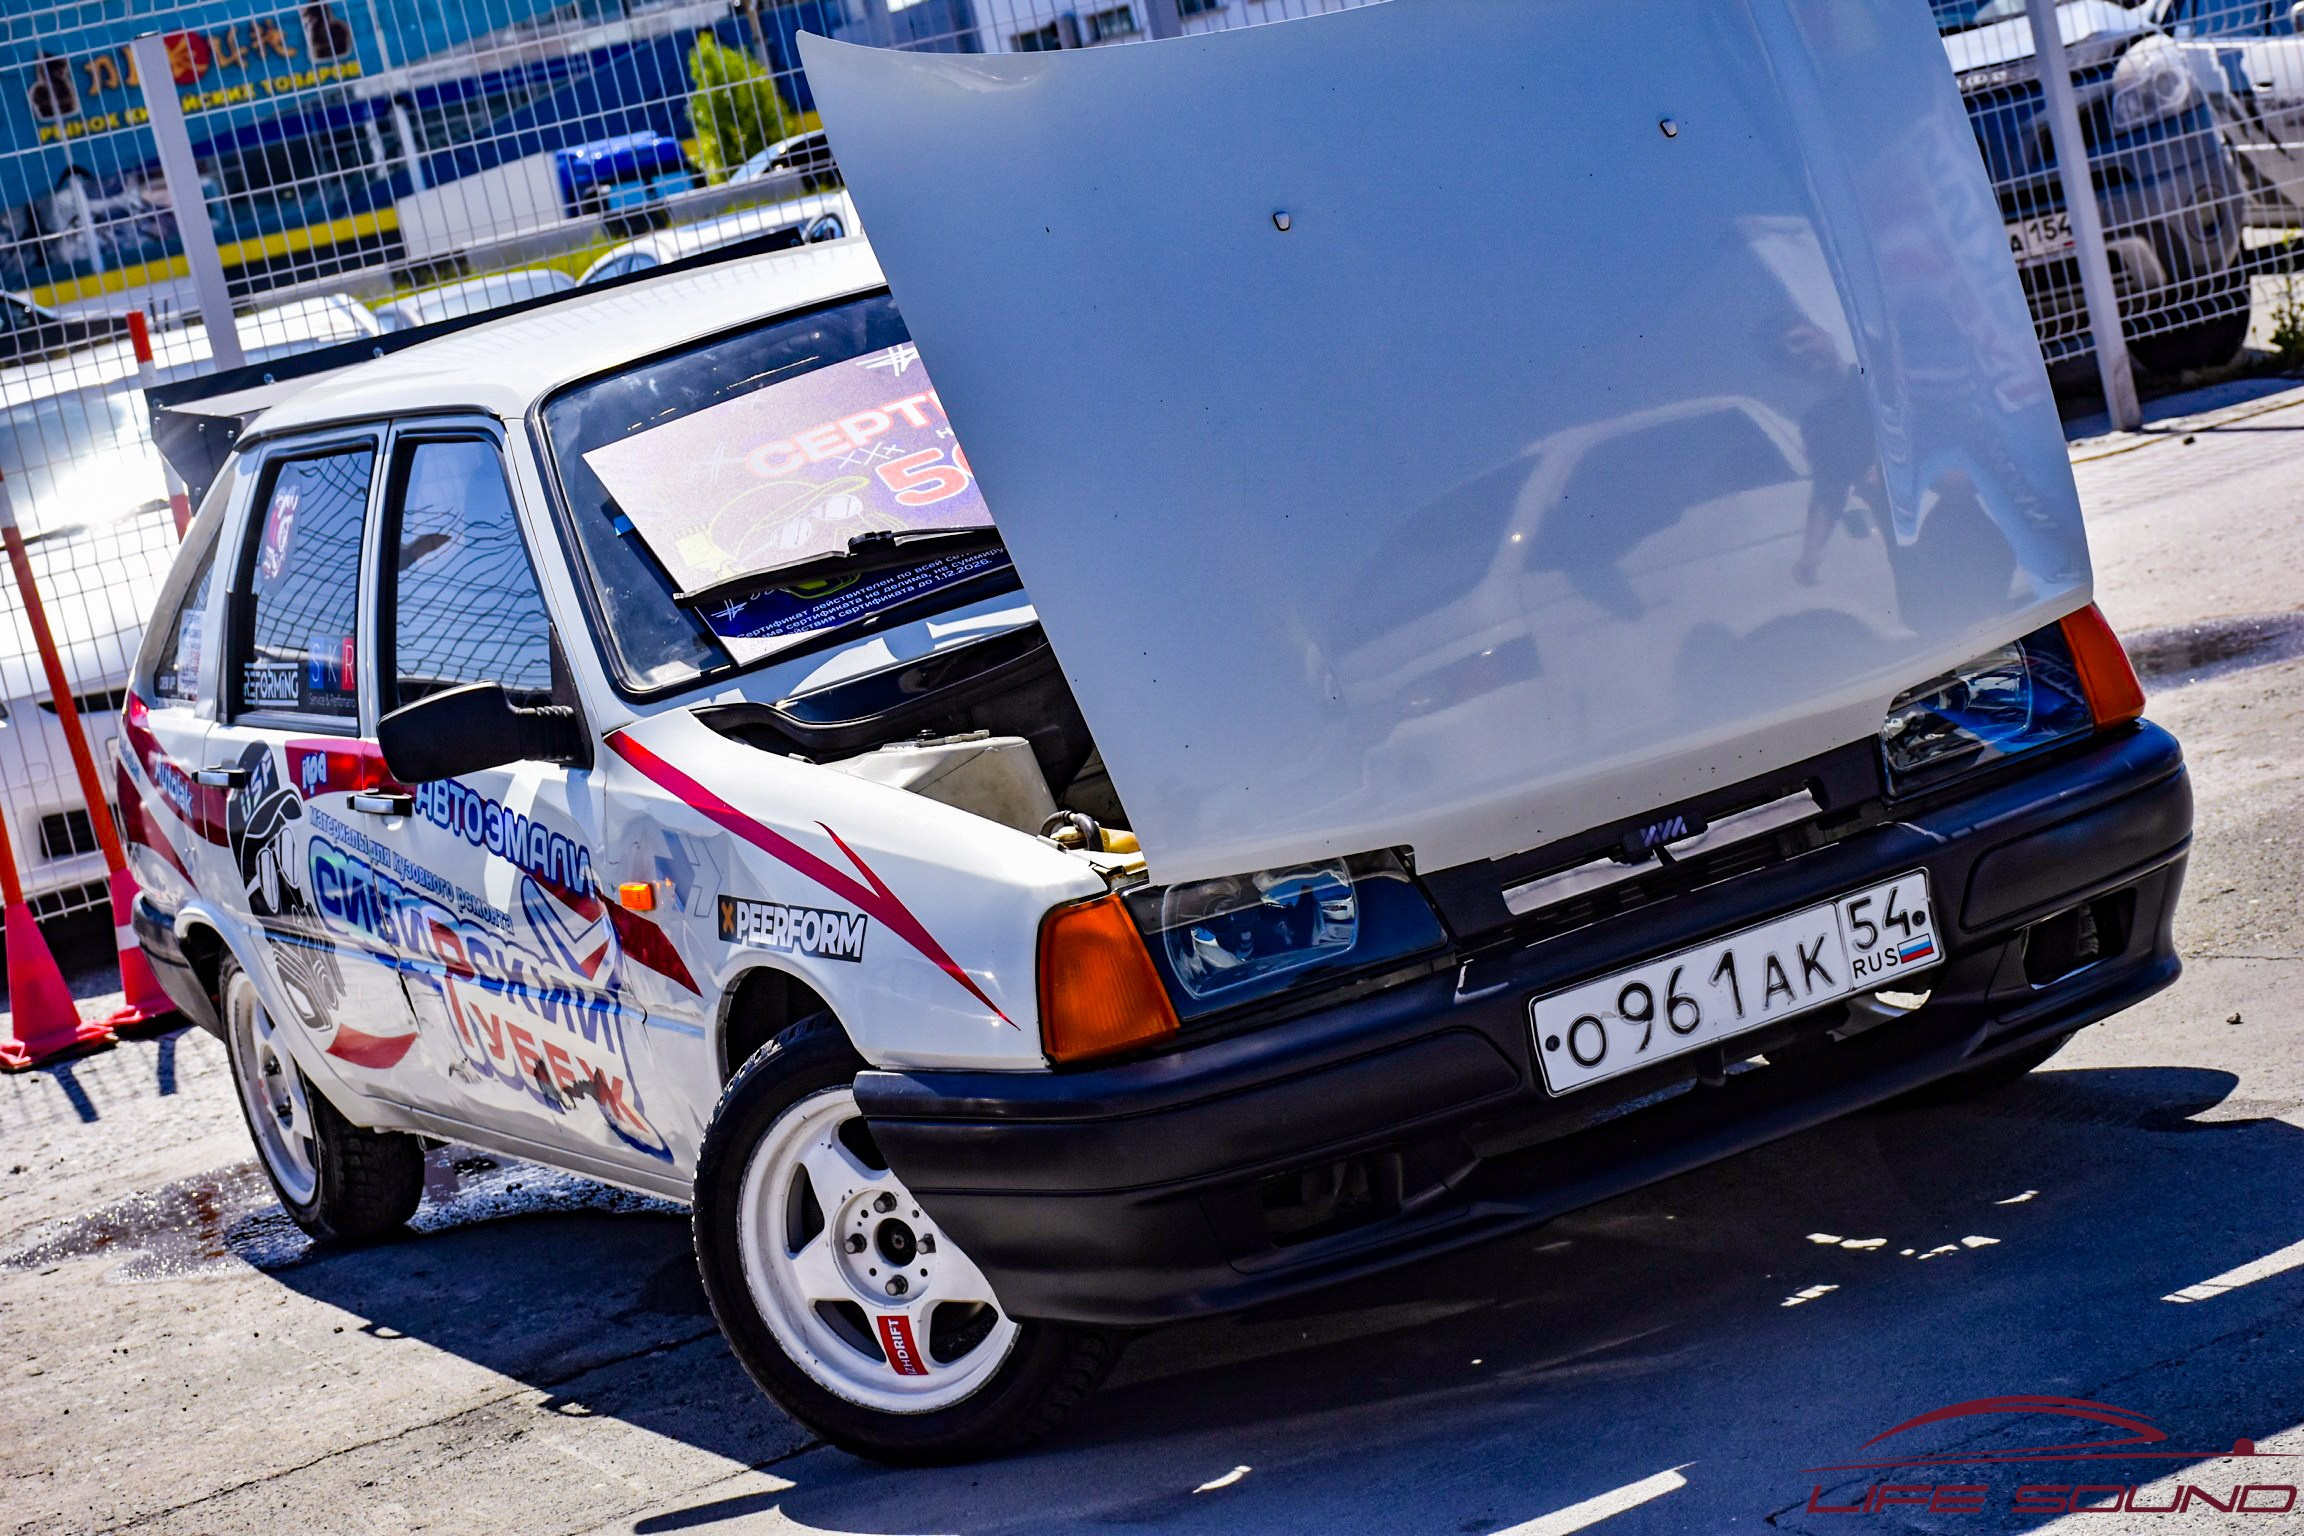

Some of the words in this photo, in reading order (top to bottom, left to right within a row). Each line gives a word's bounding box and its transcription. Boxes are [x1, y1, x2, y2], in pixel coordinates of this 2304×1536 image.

[39, 112, 120, 142] РЫНОК
[261, 60, 362, 95] ТОВАРОВ
[874, 443, 973, 506] 5
[737, 609, 808, 638] Сертификат
[813, 577, 894, 612] действителен
[897, 571, 911, 580] по
[915, 559, 943, 573] всей
[786, 596, 863, 630] сертификата
[865, 590, 880, 600] не
[884, 571, 932, 593] делима,
[934, 566, 949, 575] не
[838, 585, 915, 618] сертификата
[918, 579, 933, 588] до
[310, 805, 369, 854] материалы
[369, 839, 392, 869] для
[392, 851, 455, 903] кузовного
[456, 886, 515, 936] ремонта
[415, 779, 597, 902] АВТОЭМАЛИ
[1846, 885, 1913, 953] 54
[1852, 947, 1899, 979] RUS
